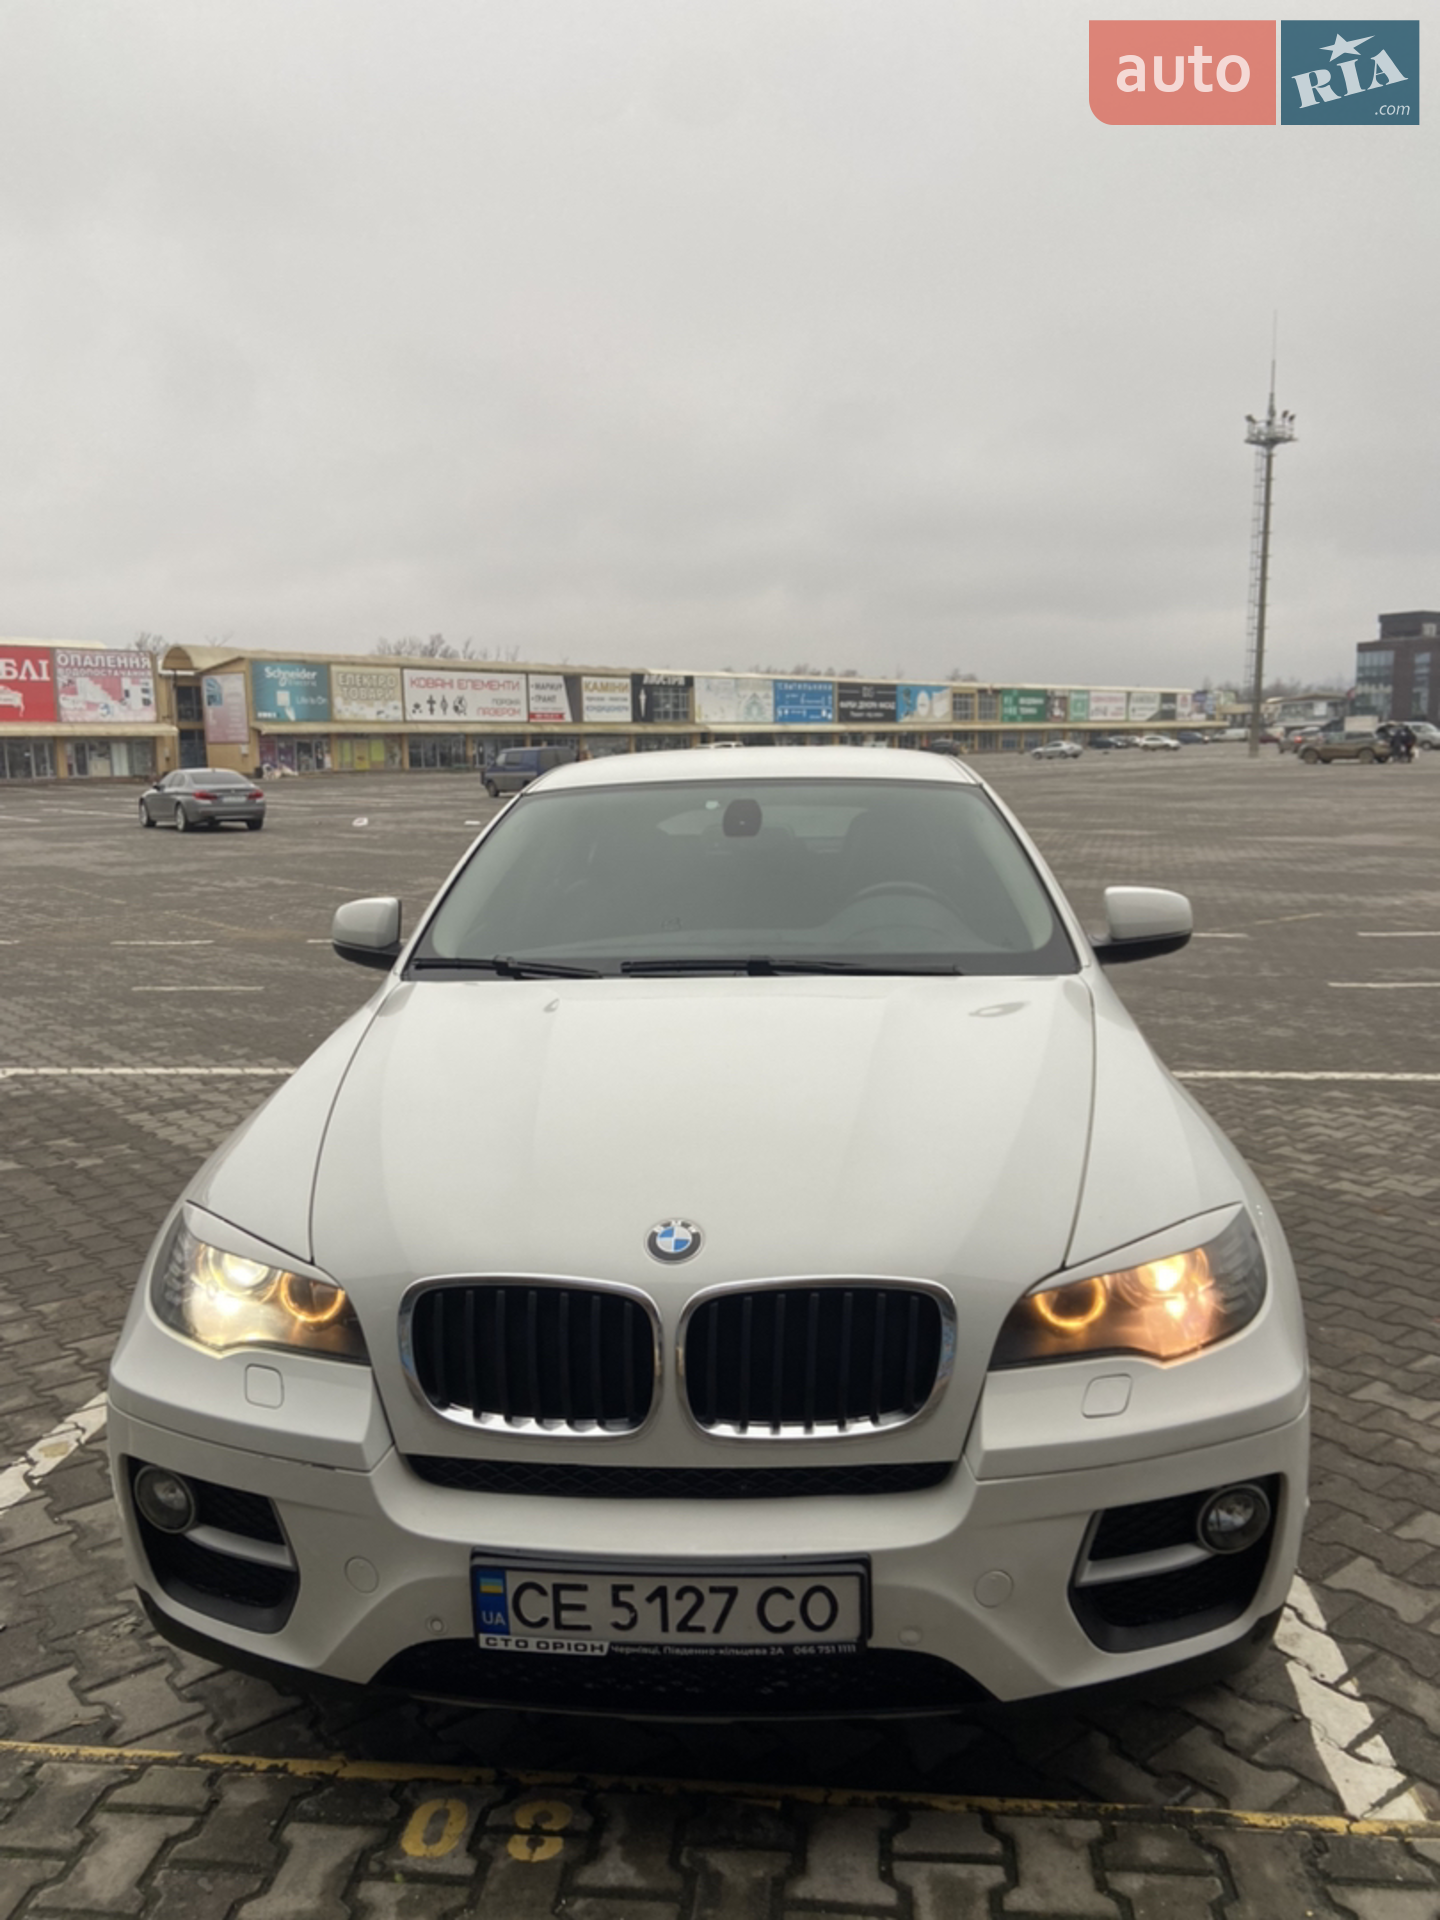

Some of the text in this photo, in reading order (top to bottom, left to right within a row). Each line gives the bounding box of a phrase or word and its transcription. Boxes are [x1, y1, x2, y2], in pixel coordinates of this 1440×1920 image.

[57, 653, 150, 669] ОПАЛЕННЯ
[264, 666, 318, 687] Schneider
[338, 673, 397, 687] ЕЛЕКТРО
[409, 677, 520, 691] КОВАНІ ЕЛЕМЕНТИ
[342, 687, 394, 700] ТОВАРИ
[583, 681, 629, 693] КАМІНИ
[481, 1582, 839, 1634] UA CE 5127 CO
[485, 1637, 529, 1649] СТО
[536, 1640, 604, 1653] ОРІОН
[793, 1645, 816, 1655] 066
[817, 1645, 836, 1654] 751
